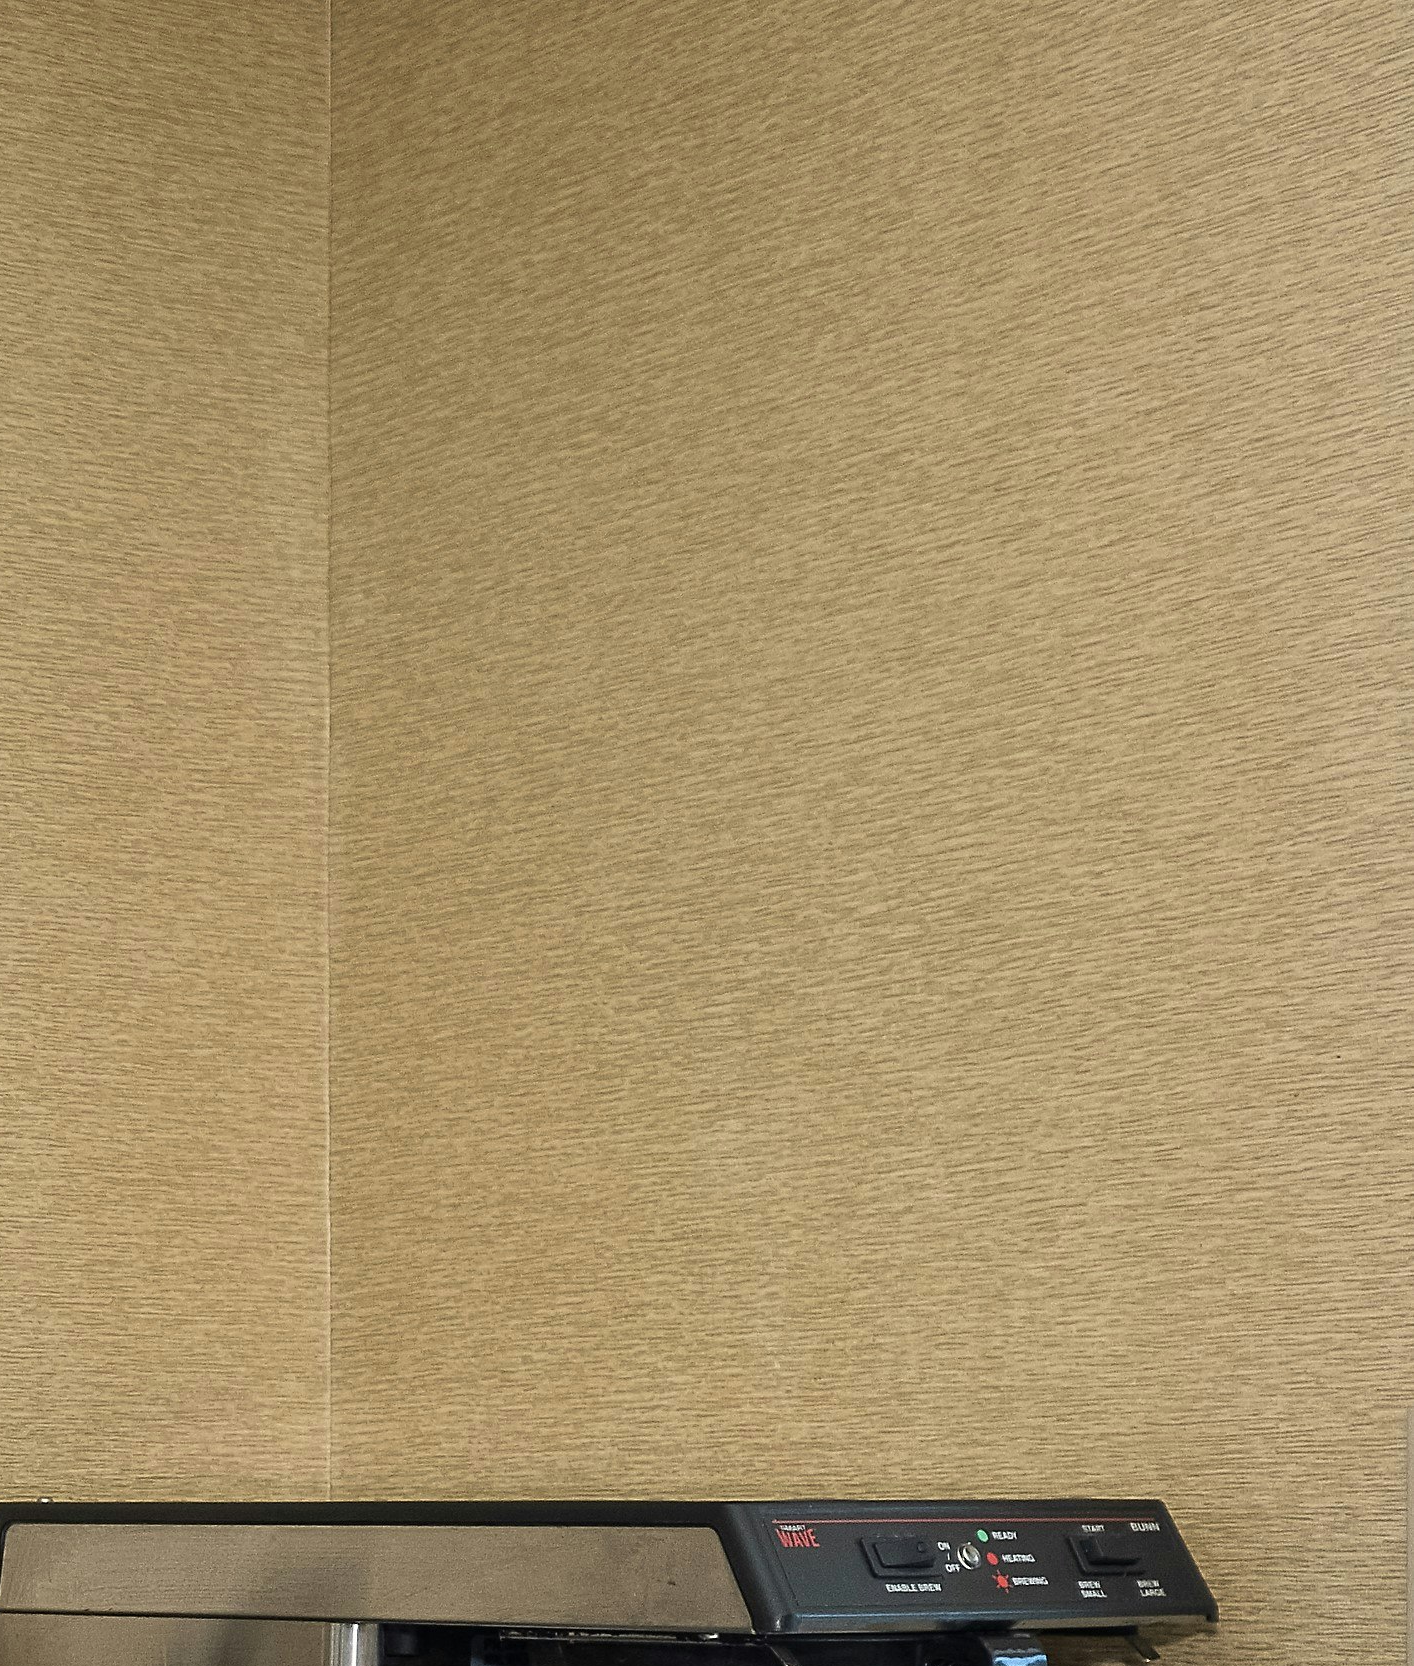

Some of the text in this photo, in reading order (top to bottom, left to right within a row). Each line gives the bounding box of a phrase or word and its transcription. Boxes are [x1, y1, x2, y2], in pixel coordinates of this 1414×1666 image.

[1082, 1525, 1105, 1533] START
[1130, 1522, 1160, 1532] BUNN
[775, 1528, 820, 1548] WAVE
[991, 1531, 1017, 1540] READY
[937, 1541, 950, 1551] ON
[1001, 1554, 1036, 1562] HEATING
[945, 1563, 960, 1573] OFF
[1012, 1576, 1049, 1586] BREWING
[1078, 1580, 1101, 1589] BREW
[1137, 1579, 1160, 1588] BREW
[885, 1583, 942, 1592] ENABLE BREW
[1080, 1589, 1107, 1598] SMALL
[1139, 1588, 1166, 1597] LARGE
